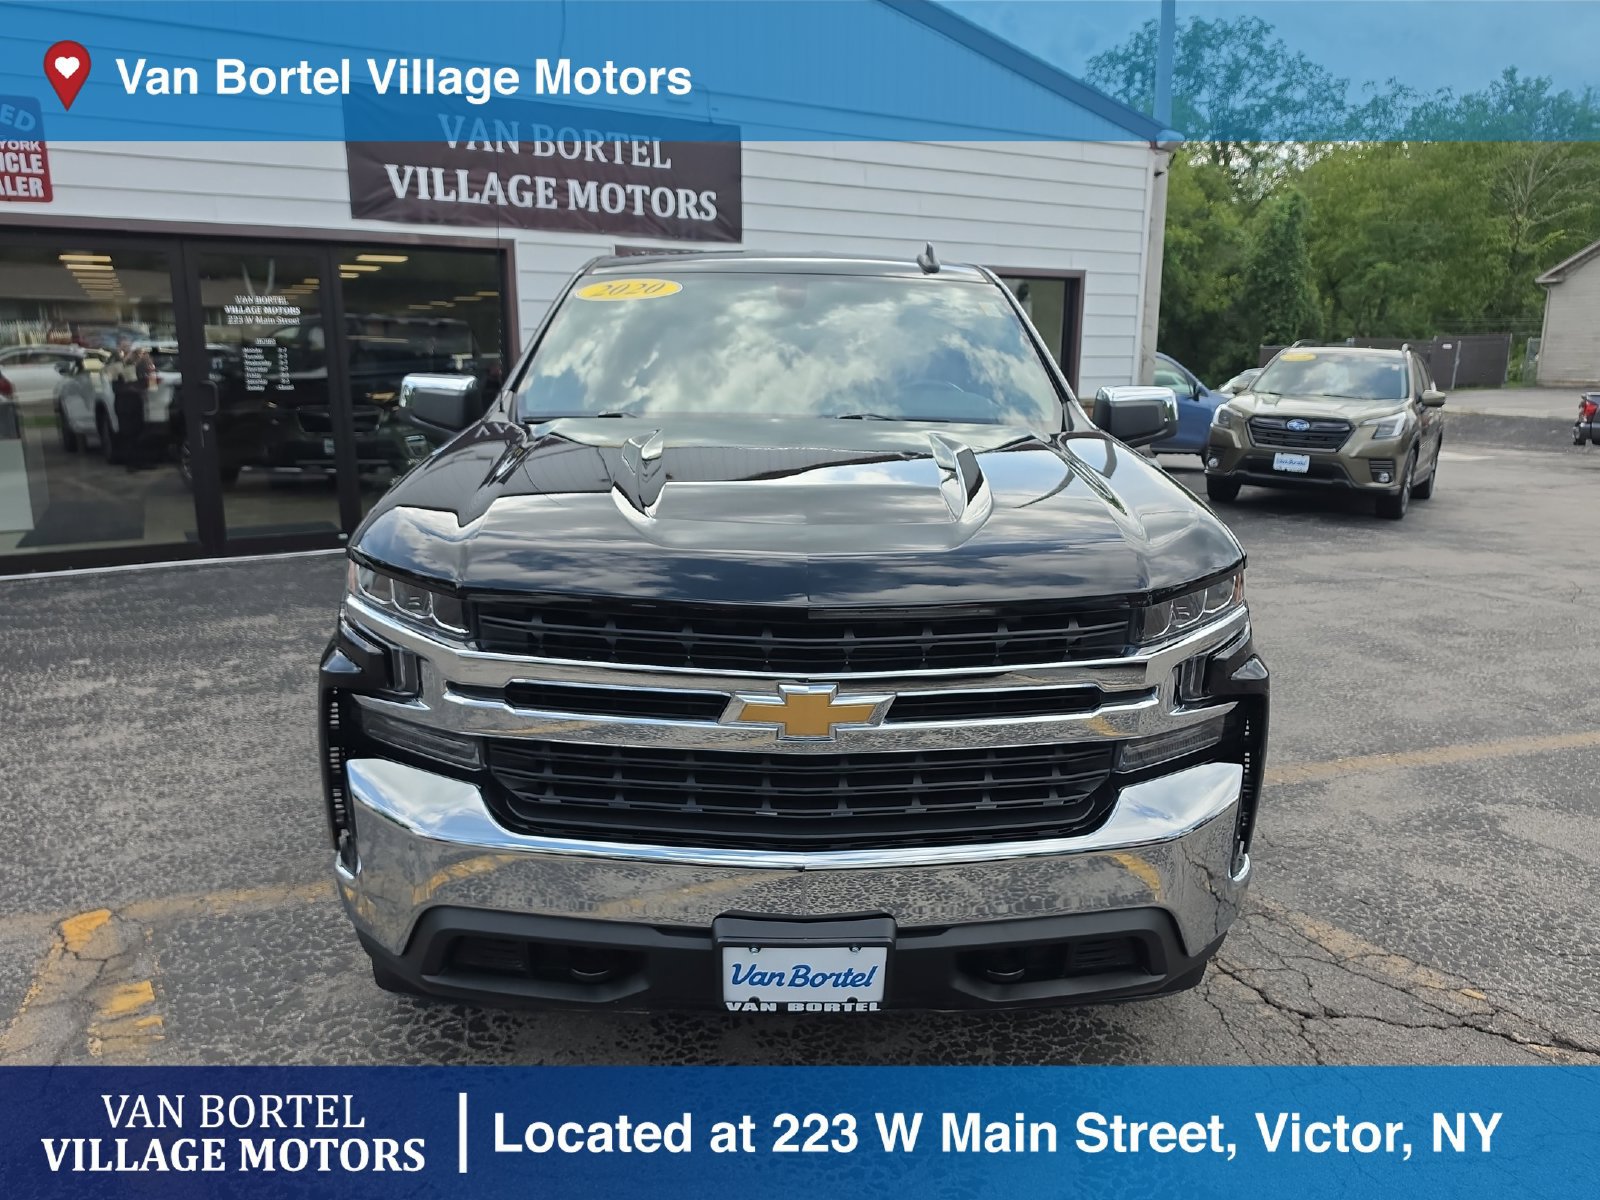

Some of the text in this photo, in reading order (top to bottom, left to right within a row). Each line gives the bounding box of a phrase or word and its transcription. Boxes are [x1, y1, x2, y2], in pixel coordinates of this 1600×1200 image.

[437, 112, 673, 170] VAN BORTEL
[384, 164, 718, 222] VILLAGE MOTORS
[591, 281, 667, 298] 2020
[235, 295, 254, 304] VAN
[224, 305, 301, 315] VILLAGE MOTORS
[255, 316, 276, 325] Main
[276, 316, 301, 325] Street
[731, 963, 880, 988] Van Bortel
[725, 1002, 881, 1012] VAN BORTEL
